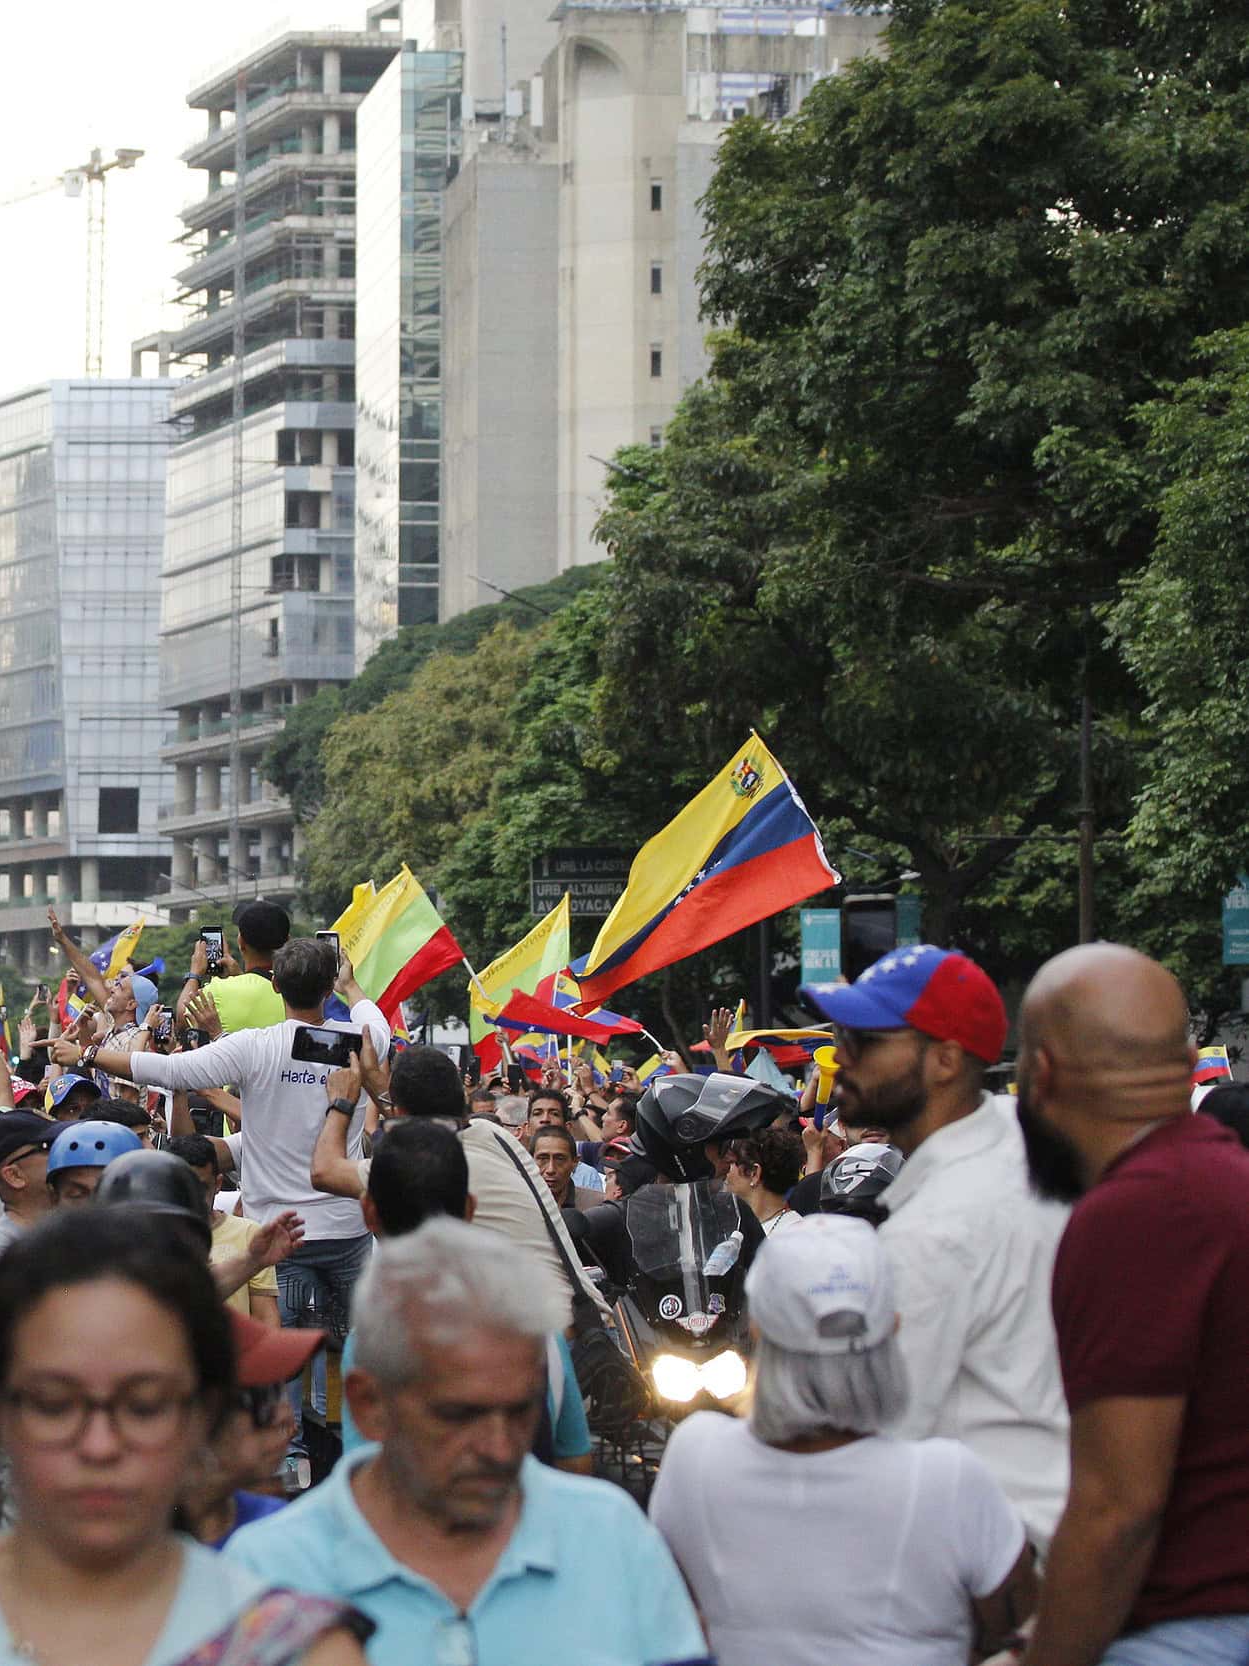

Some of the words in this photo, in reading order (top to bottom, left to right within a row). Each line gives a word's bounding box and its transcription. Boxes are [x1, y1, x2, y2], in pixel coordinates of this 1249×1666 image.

[568, 882, 623, 896] ALTAMIRA
[571, 899, 612, 912] OYACA
[281, 1069, 316, 1085] Hasta
